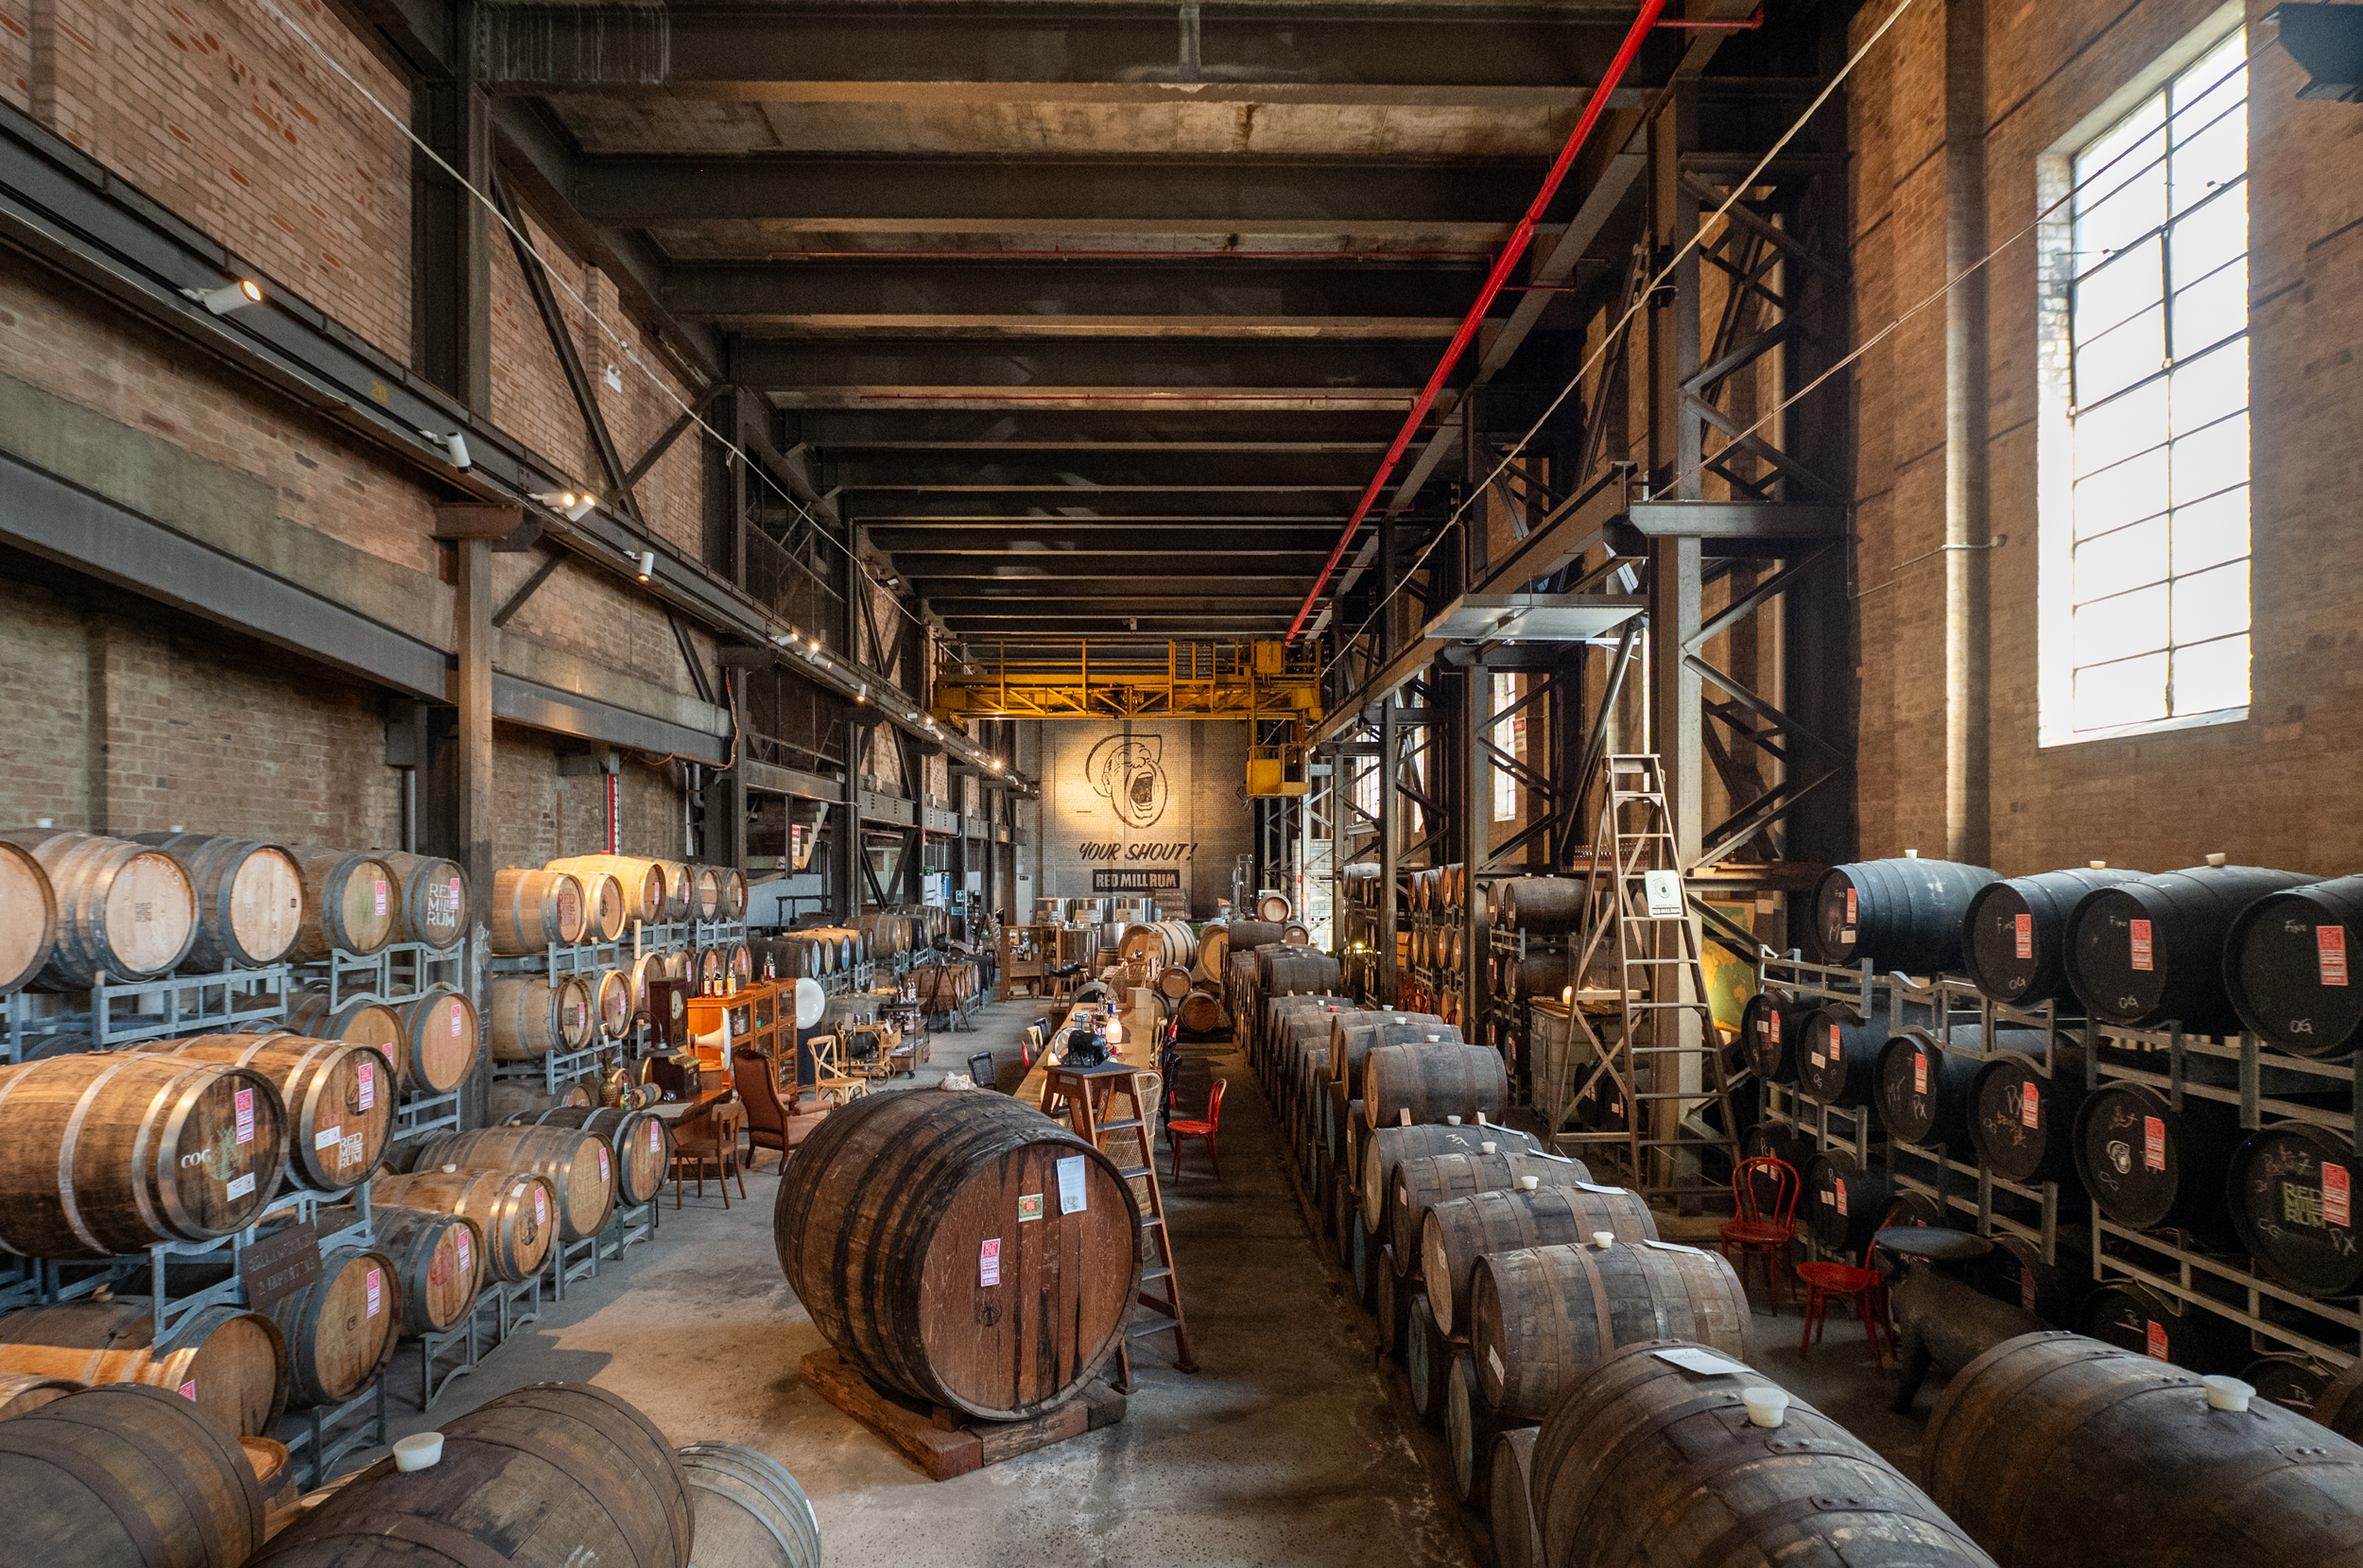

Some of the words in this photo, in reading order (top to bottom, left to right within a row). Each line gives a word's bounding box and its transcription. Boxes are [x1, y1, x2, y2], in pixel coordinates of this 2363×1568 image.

[1079, 841, 1122, 861] YOUR
[1125, 842, 1199, 861] SHOUT!
[1096, 873, 1118, 887] RED
[1120, 873, 1148, 887] MILL
[1149, 873, 1177, 887] RUM
[426, 911, 455, 927] RUM
[339, 1132, 363, 1147] RED
[339, 1153, 362, 1169] RUM
